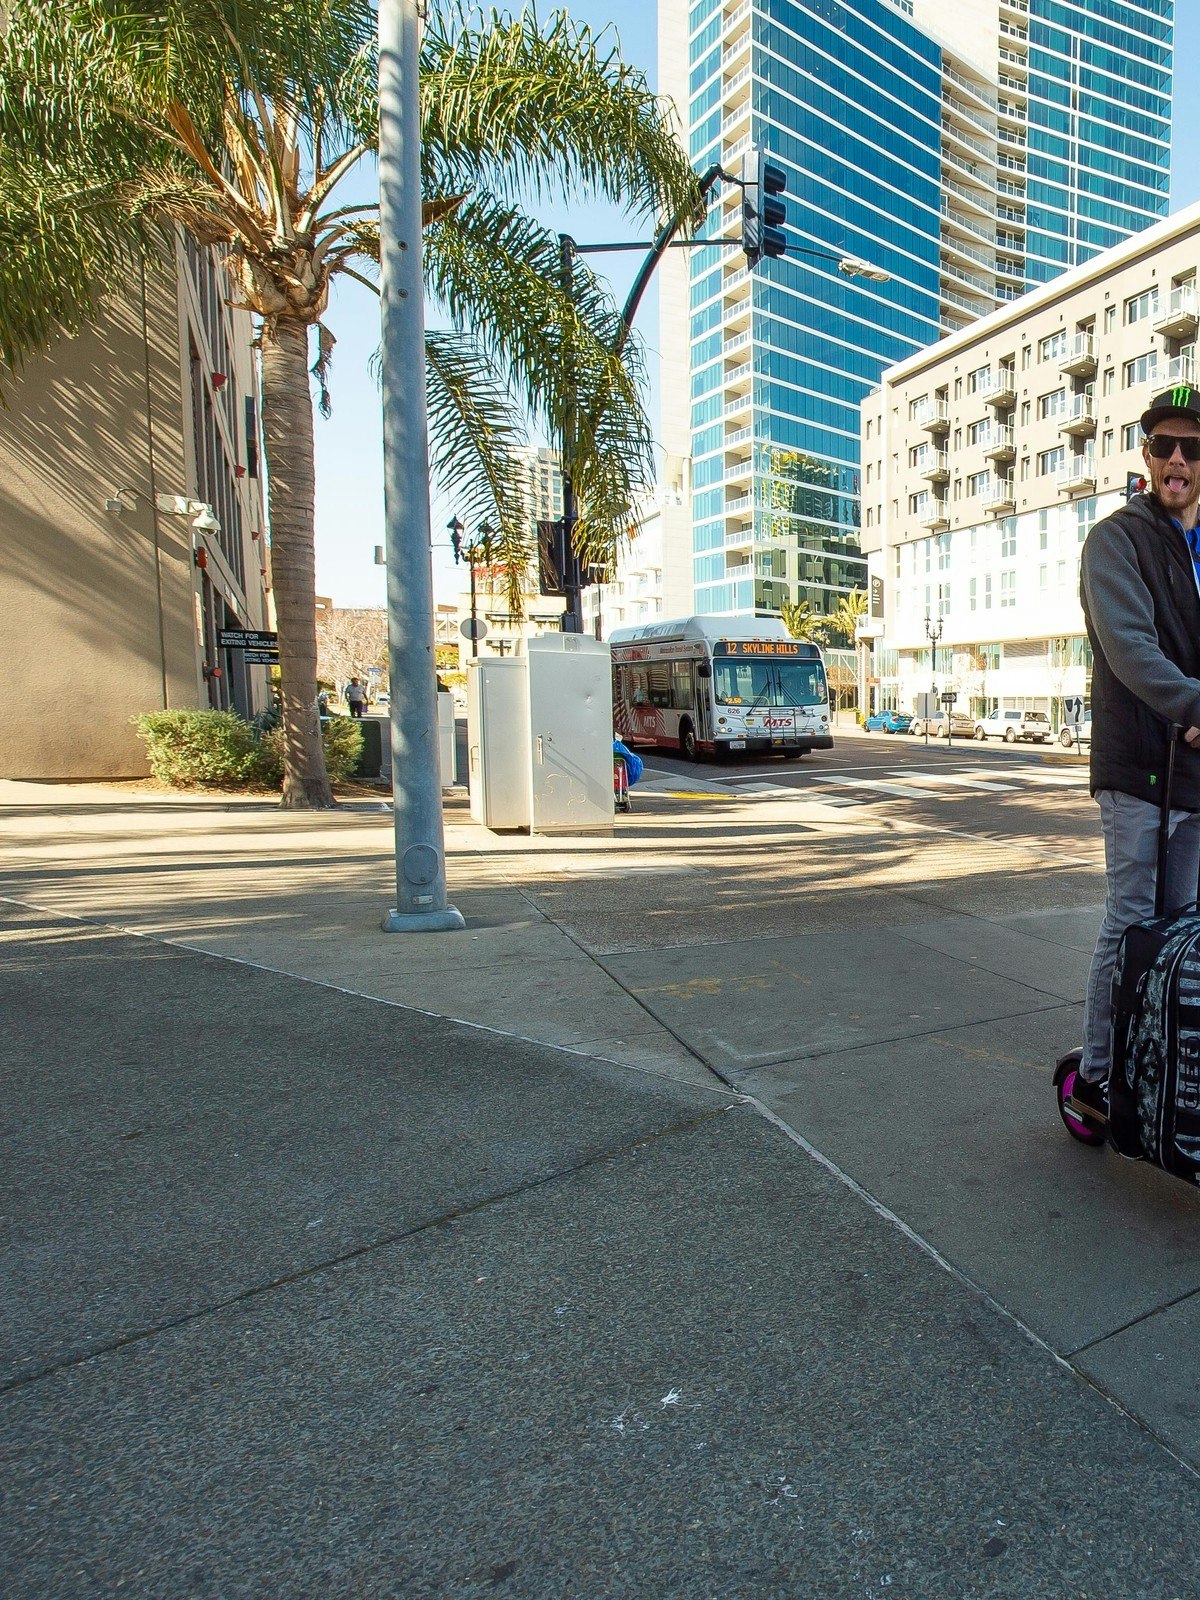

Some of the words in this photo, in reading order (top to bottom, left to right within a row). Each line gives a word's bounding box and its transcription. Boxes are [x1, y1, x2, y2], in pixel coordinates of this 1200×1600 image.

[727, 642, 738, 654] 12
[742, 643, 775, 654] SKYLINE
[776, 644, 798, 654] HILLS
[643, 716, 656, 728] MTS
[763, 718, 793, 727] MTS
